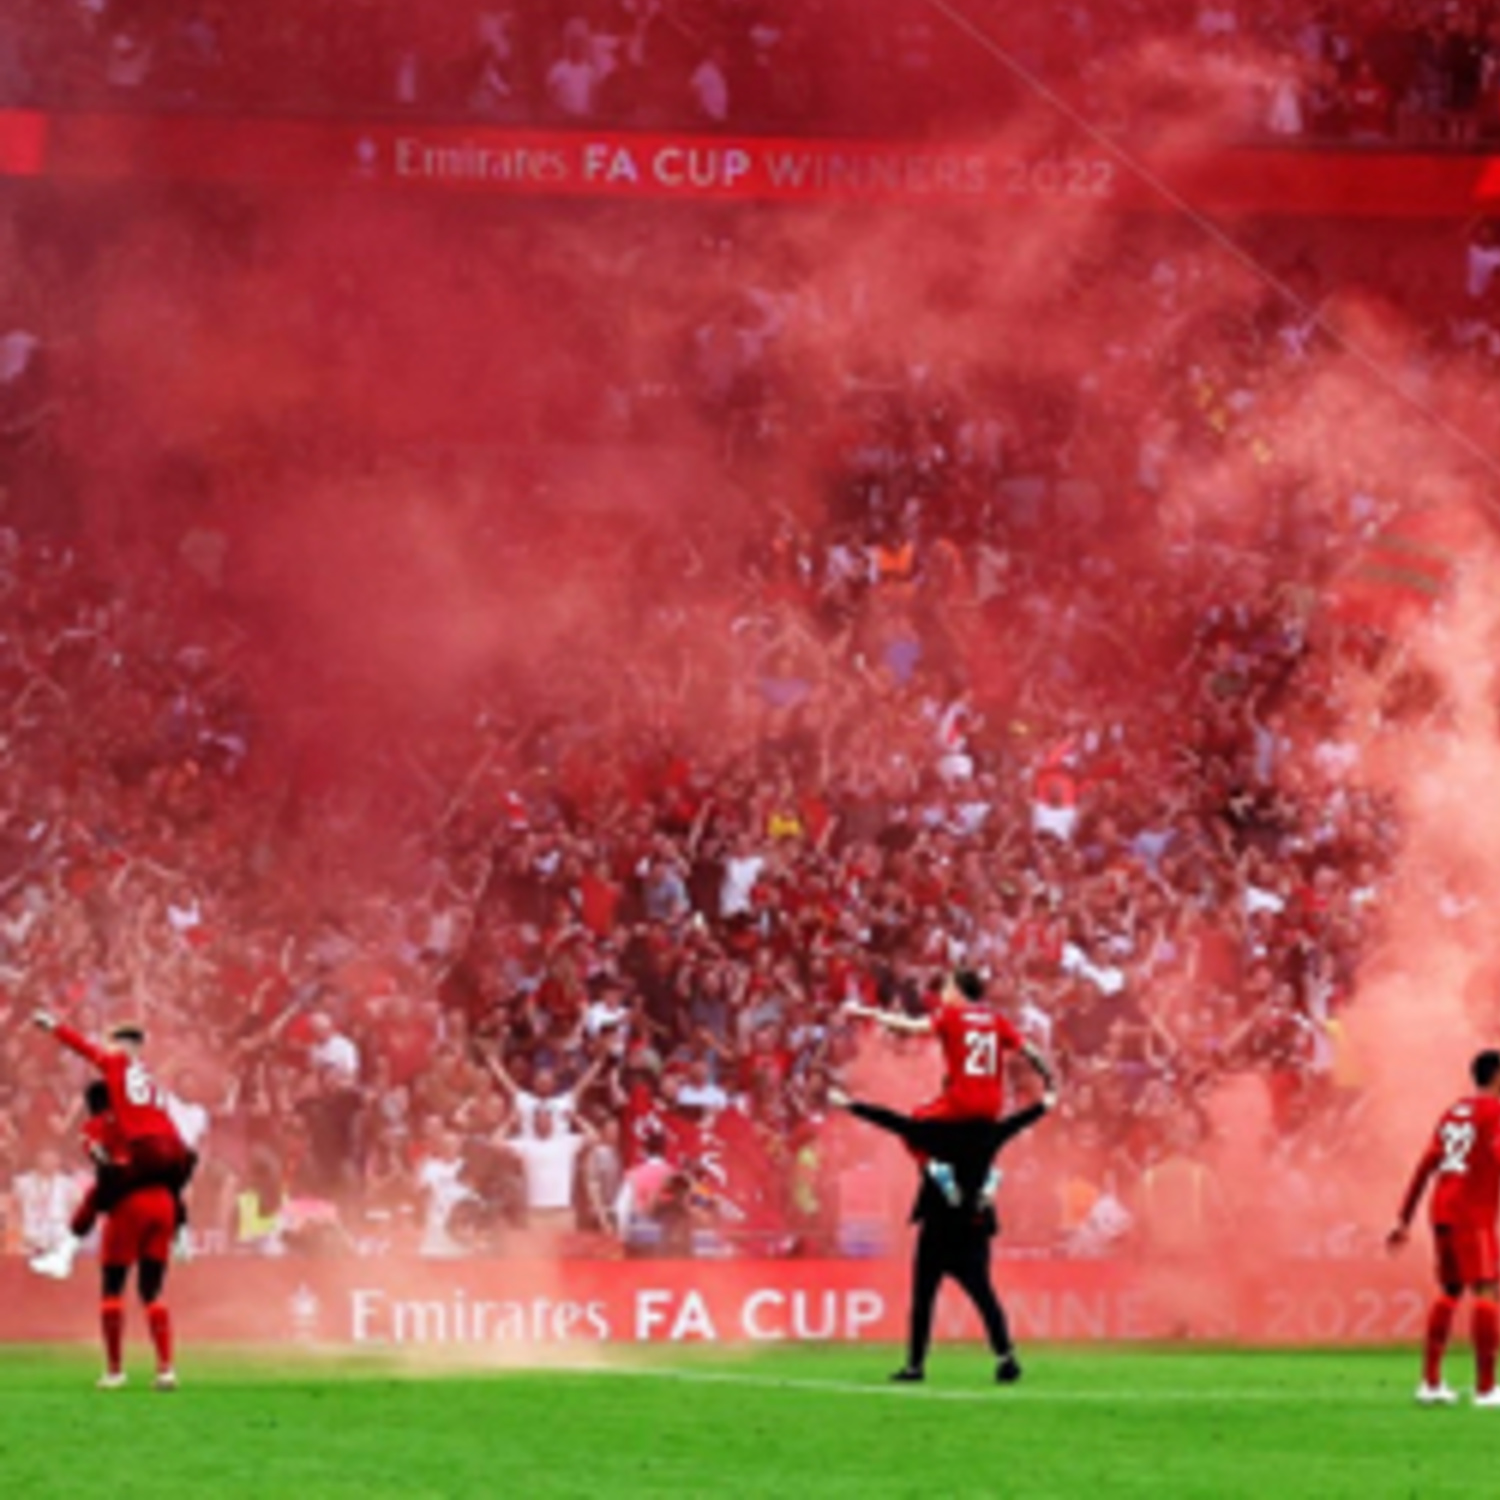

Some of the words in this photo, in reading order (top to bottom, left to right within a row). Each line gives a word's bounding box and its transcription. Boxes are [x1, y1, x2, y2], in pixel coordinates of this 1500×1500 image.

[395, 137, 567, 182] Emirates
[581, 146, 638, 184] FA
[652, 148, 752, 189] CUP
[764, 152, 987, 195] WINNERS
[1002, 162, 1116, 199] 2022
[963, 1031, 998, 1076] 21
[349, 1288, 610, 1342] Emirates
[635, 1289, 717, 1340] FA
[742, 1288, 885, 1340] CUP
[1264, 1288, 1425, 1340] 2022
